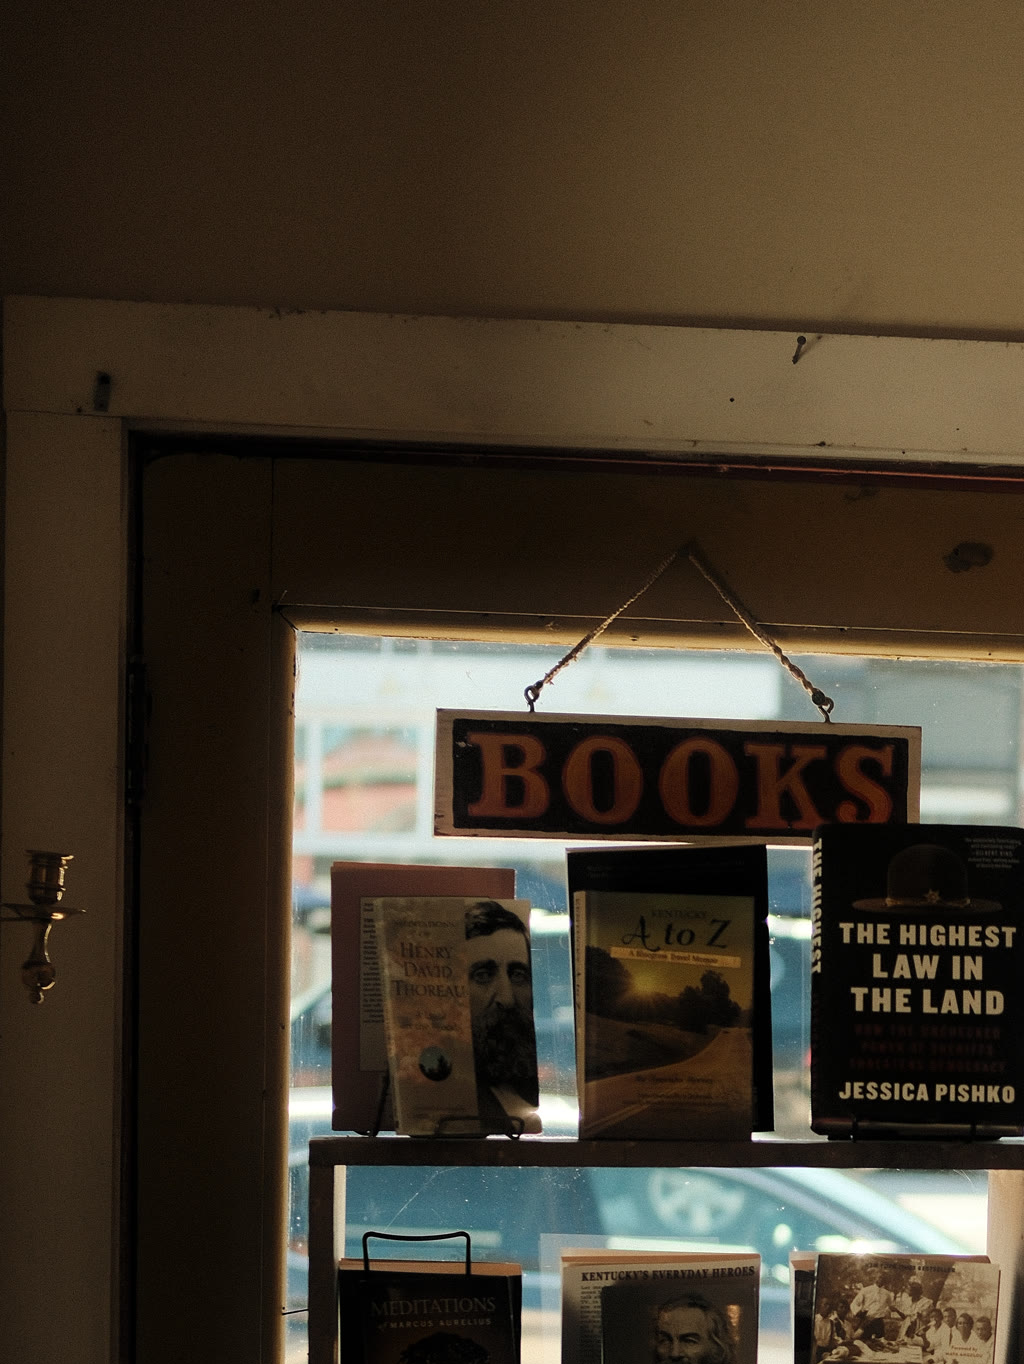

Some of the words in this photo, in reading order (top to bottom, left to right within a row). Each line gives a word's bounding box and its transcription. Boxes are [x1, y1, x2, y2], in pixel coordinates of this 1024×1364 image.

[468, 732, 895, 830] BOOKS
[813, 837, 822, 877] THE
[622, 915, 661, 952] A
[665, 923, 695, 946] to
[707, 918, 730, 949] Z
[811, 883, 822, 973] HIGHEST
[838, 922, 891, 945] THE
[899, 923, 1017, 949] HIGHEST
[400, 942, 454, 959] HENRY
[403, 961, 454, 978] DAVID
[872, 953, 940, 980] LAW
[952, 955, 983, 981] IN
[391, 980, 465, 998] THOREAU
[850, 986, 912, 1014] THE
[922, 989, 1006, 1016] LAND
[838, 1080, 929, 1101] JESSICA
[935, 1083, 1016, 1104] PISHKO
[581, 1270, 649, 1282] KENTUCKY'S
[652, 1268, 709, 1281] EVERYDAY
[712, 1266, 756, 1278] HEROES
[371, 1296, 497, 1318] MEDITATIONS
[389, 1320, 434, 1329] MARCUS
[439, 1317, 492, 1327] AURELIUS
